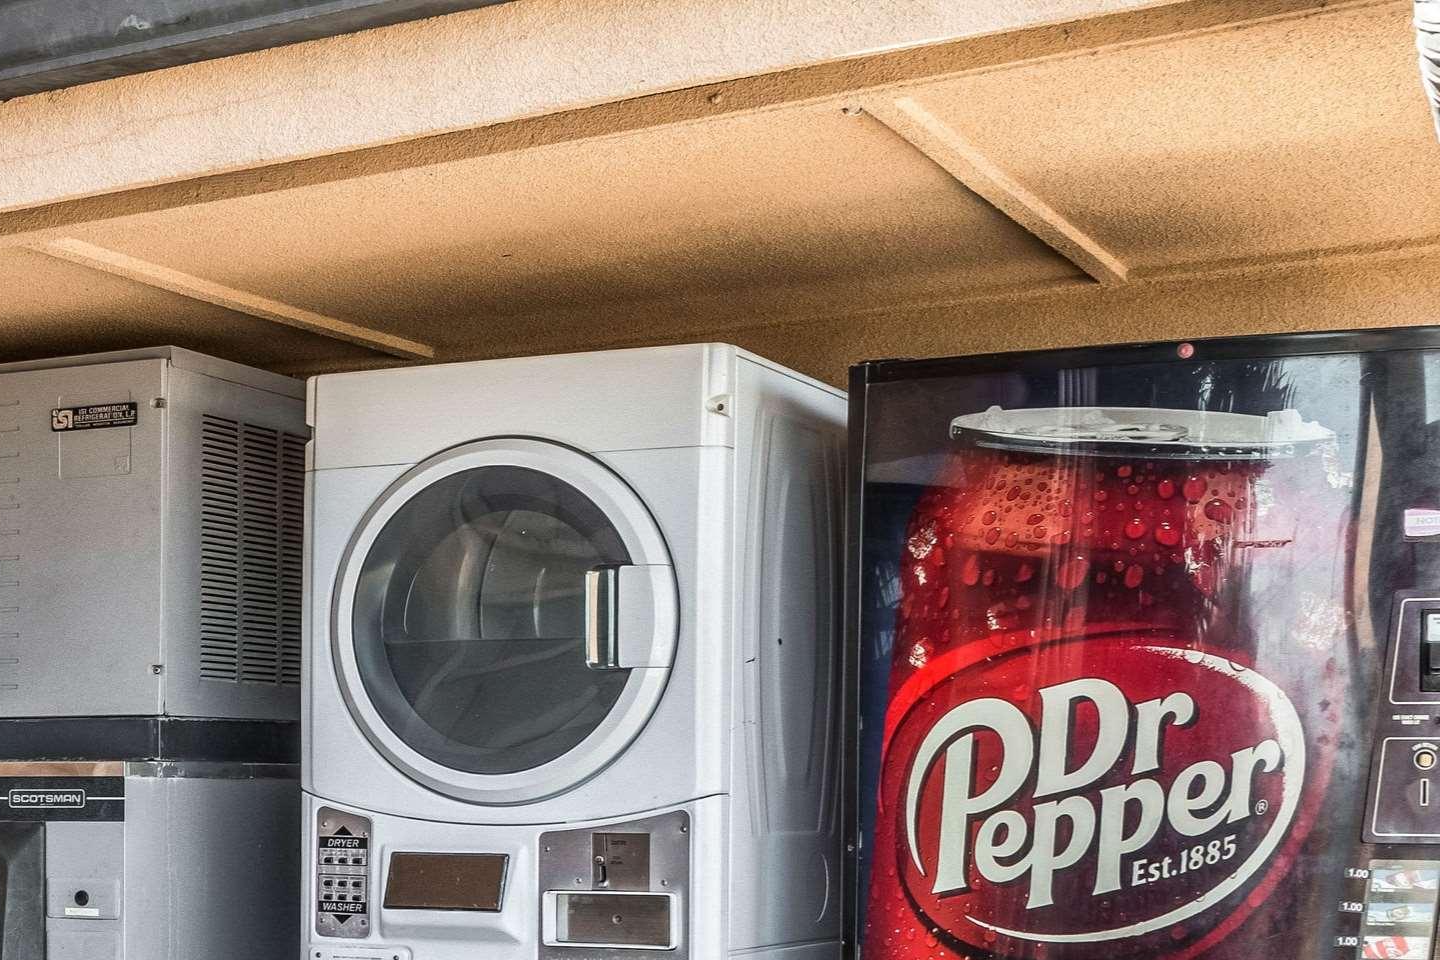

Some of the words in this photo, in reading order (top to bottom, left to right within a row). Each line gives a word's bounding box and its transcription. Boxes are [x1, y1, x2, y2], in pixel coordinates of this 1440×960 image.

[1032, 678, 1194, 798] Dr
[12, 793, 81, 804] SCOTSMAN
[906, 697, 1283, 910] Pepper
[327, 838, 360, 848] DRYER
[1348, 868, 1369, 879] 1.00
[322, 902, 363, 912] WASHER
[1342, 902, 1363, 912] 1.00
[1337, 936, 1358, 946] 1.00
